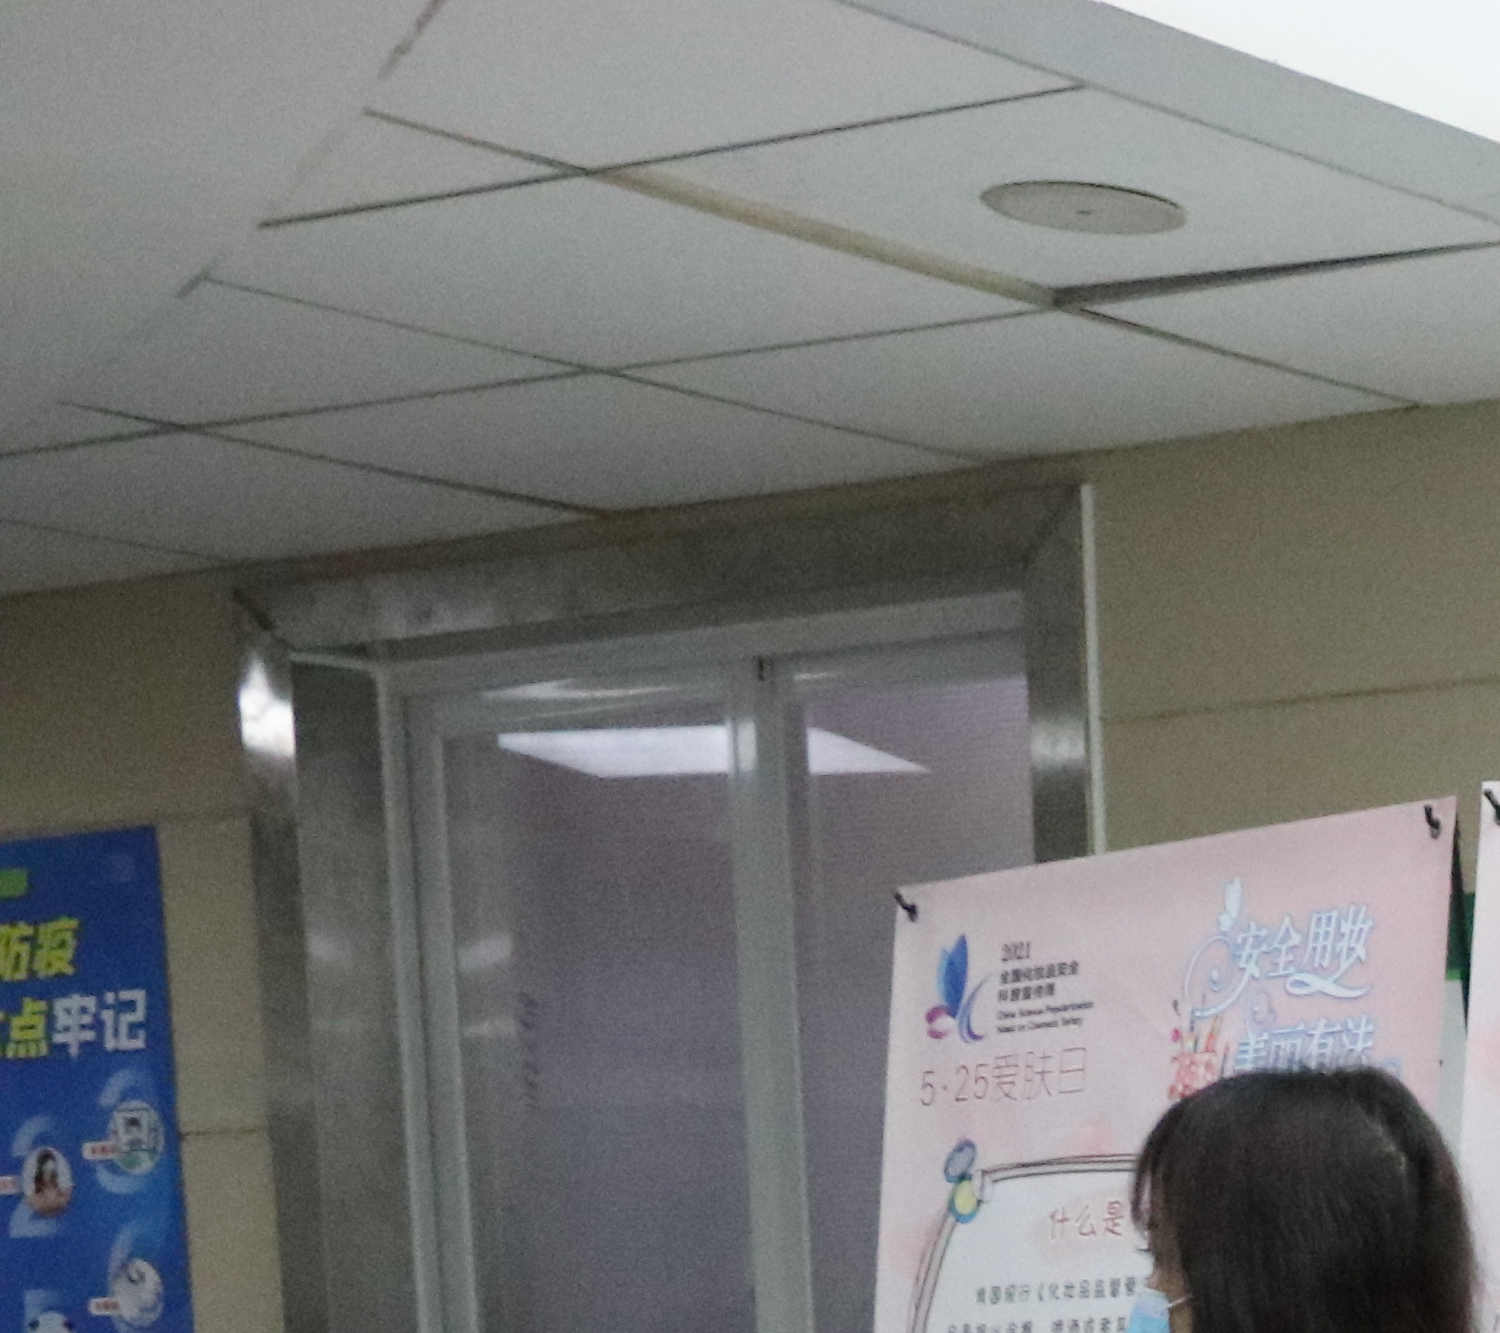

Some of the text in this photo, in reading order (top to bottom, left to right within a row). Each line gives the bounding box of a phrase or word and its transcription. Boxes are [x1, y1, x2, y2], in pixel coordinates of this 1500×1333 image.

[1236, 905, 1373, 997] 安全用妆
[0, 988, 147, 1060] 点牢记
[1049, 1199, 1125, 1239] 什么是
